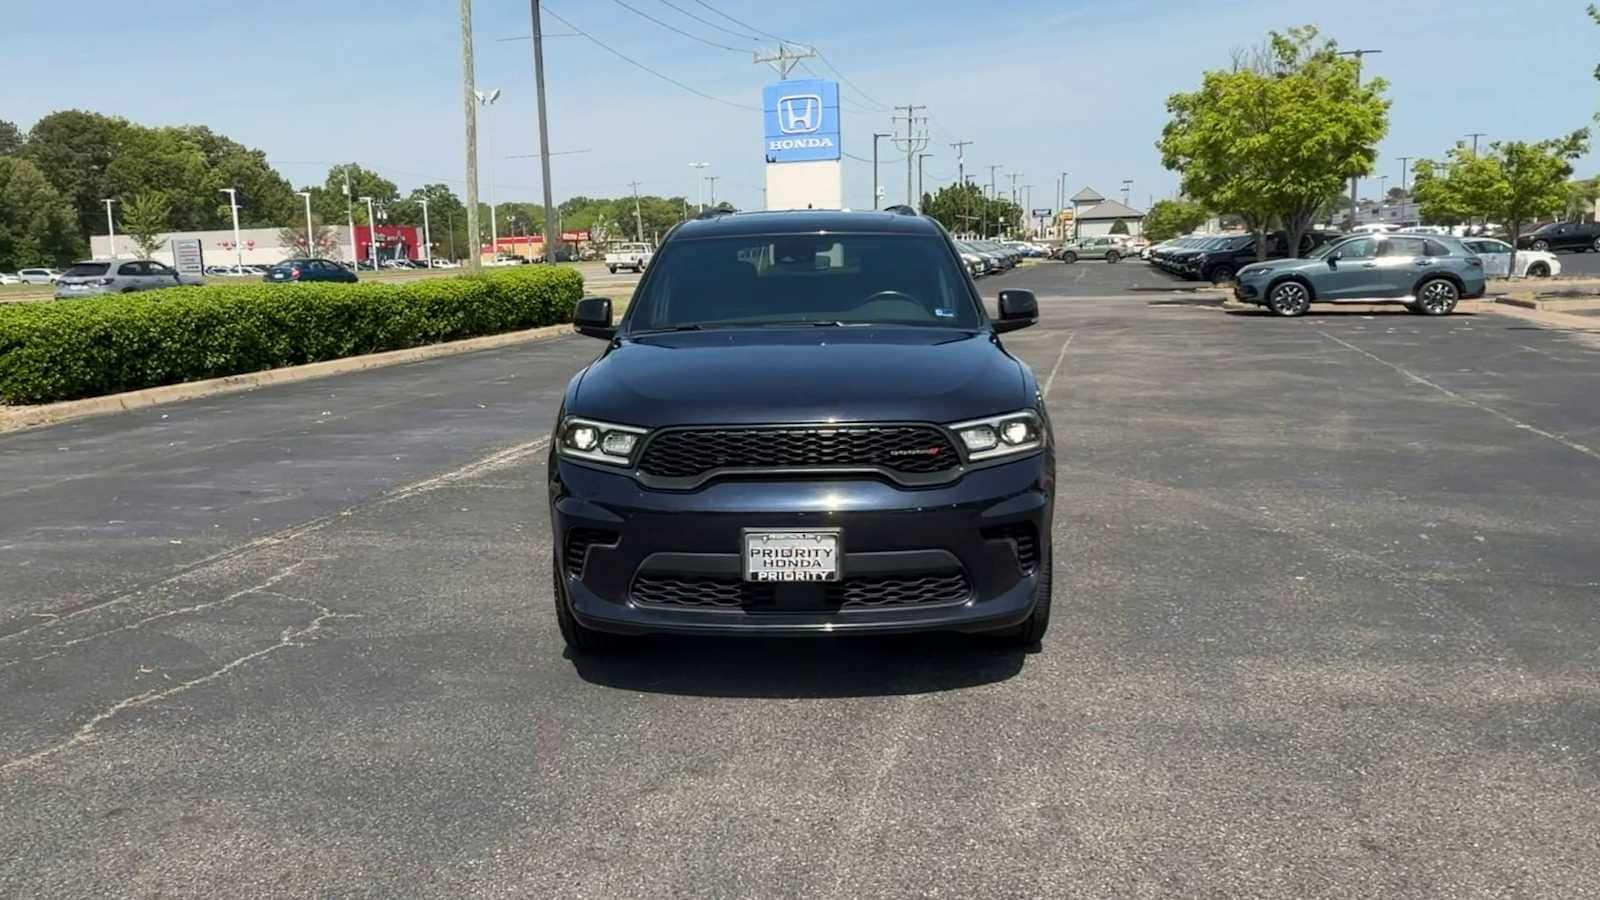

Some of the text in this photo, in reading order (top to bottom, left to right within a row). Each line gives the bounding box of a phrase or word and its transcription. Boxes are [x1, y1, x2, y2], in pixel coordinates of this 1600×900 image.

[769, 138, 833, 150] HONDA
[750, 548, 832, 558] PRIORITY
[763, 559, 822, 568] HONDA
[758, 571, 829, 581] PRIORITY
